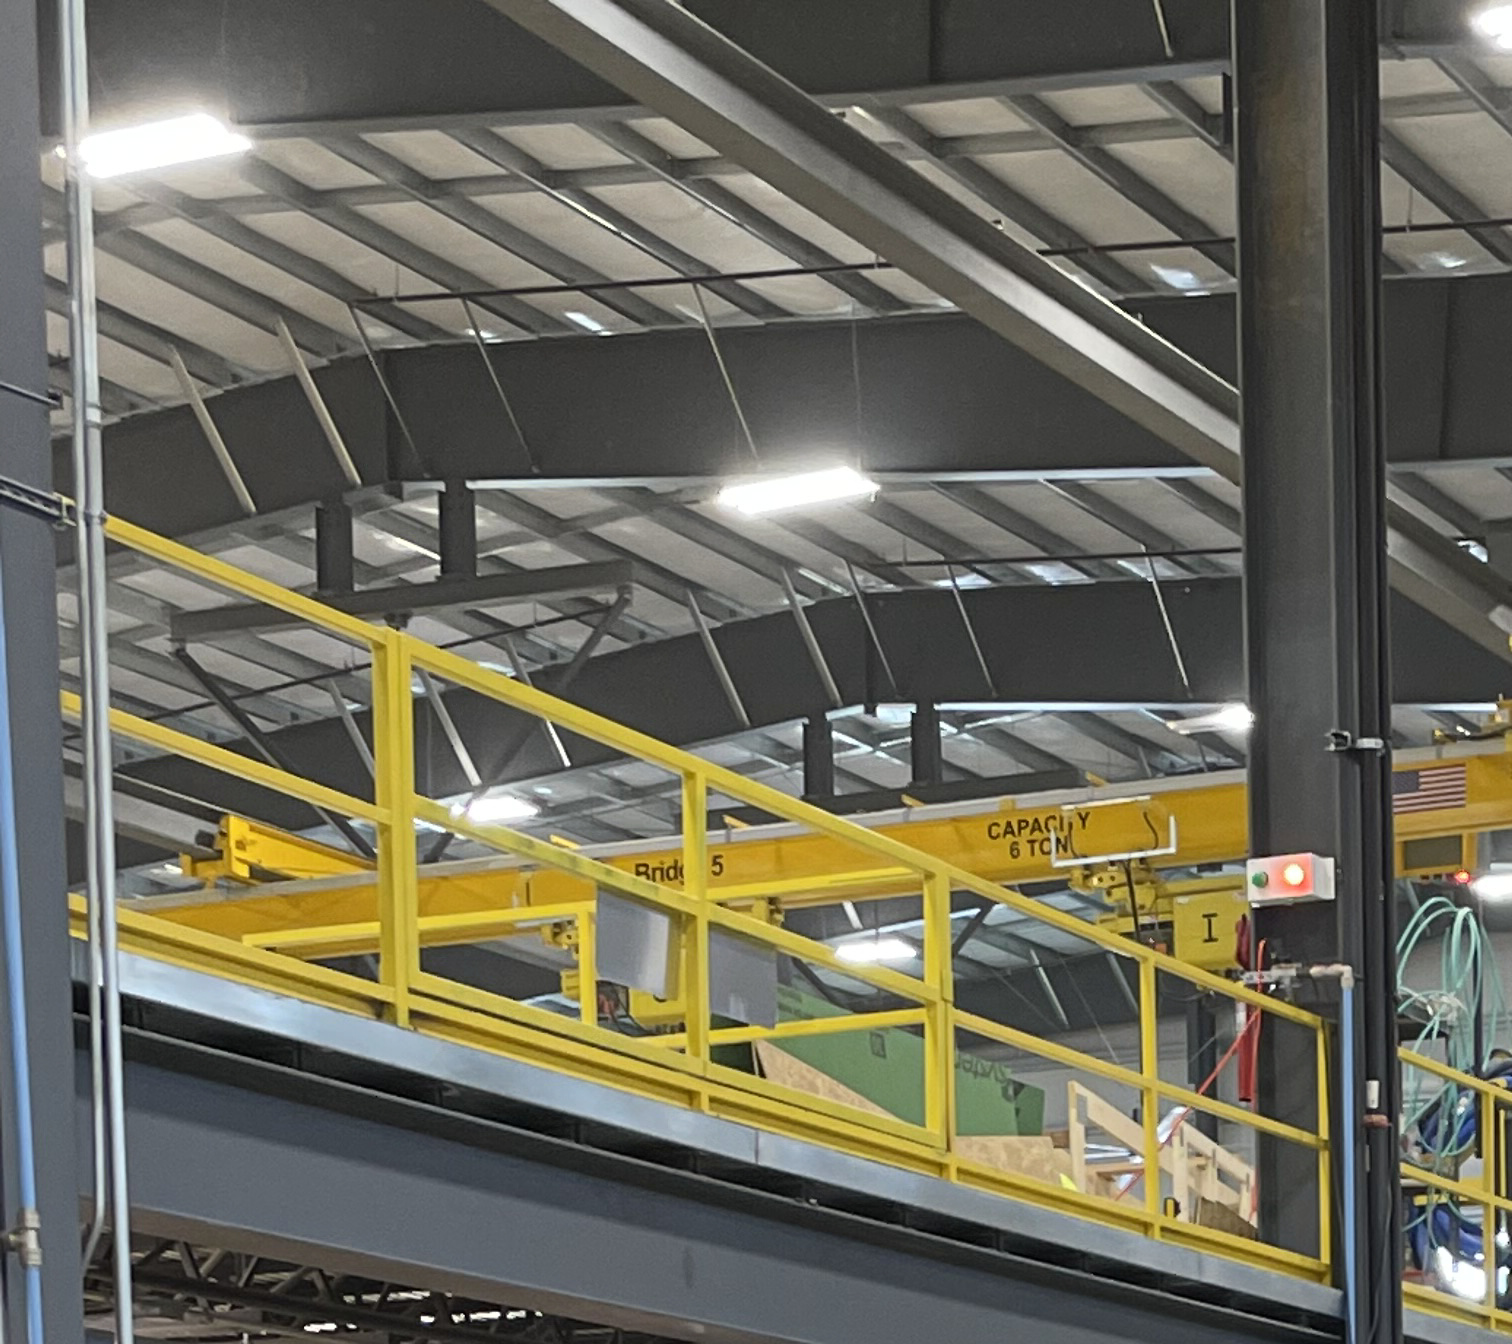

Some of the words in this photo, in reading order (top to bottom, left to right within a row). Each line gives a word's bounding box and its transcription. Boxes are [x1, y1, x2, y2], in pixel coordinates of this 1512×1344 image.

[987, 811, 1091, 841] CAPACIY
[1009, 841, 1021, 860] 6
[635, 858, 684, 886] Brid
[711, 854, 724, 877] 5
[1202, 912, 1219, 943] I
